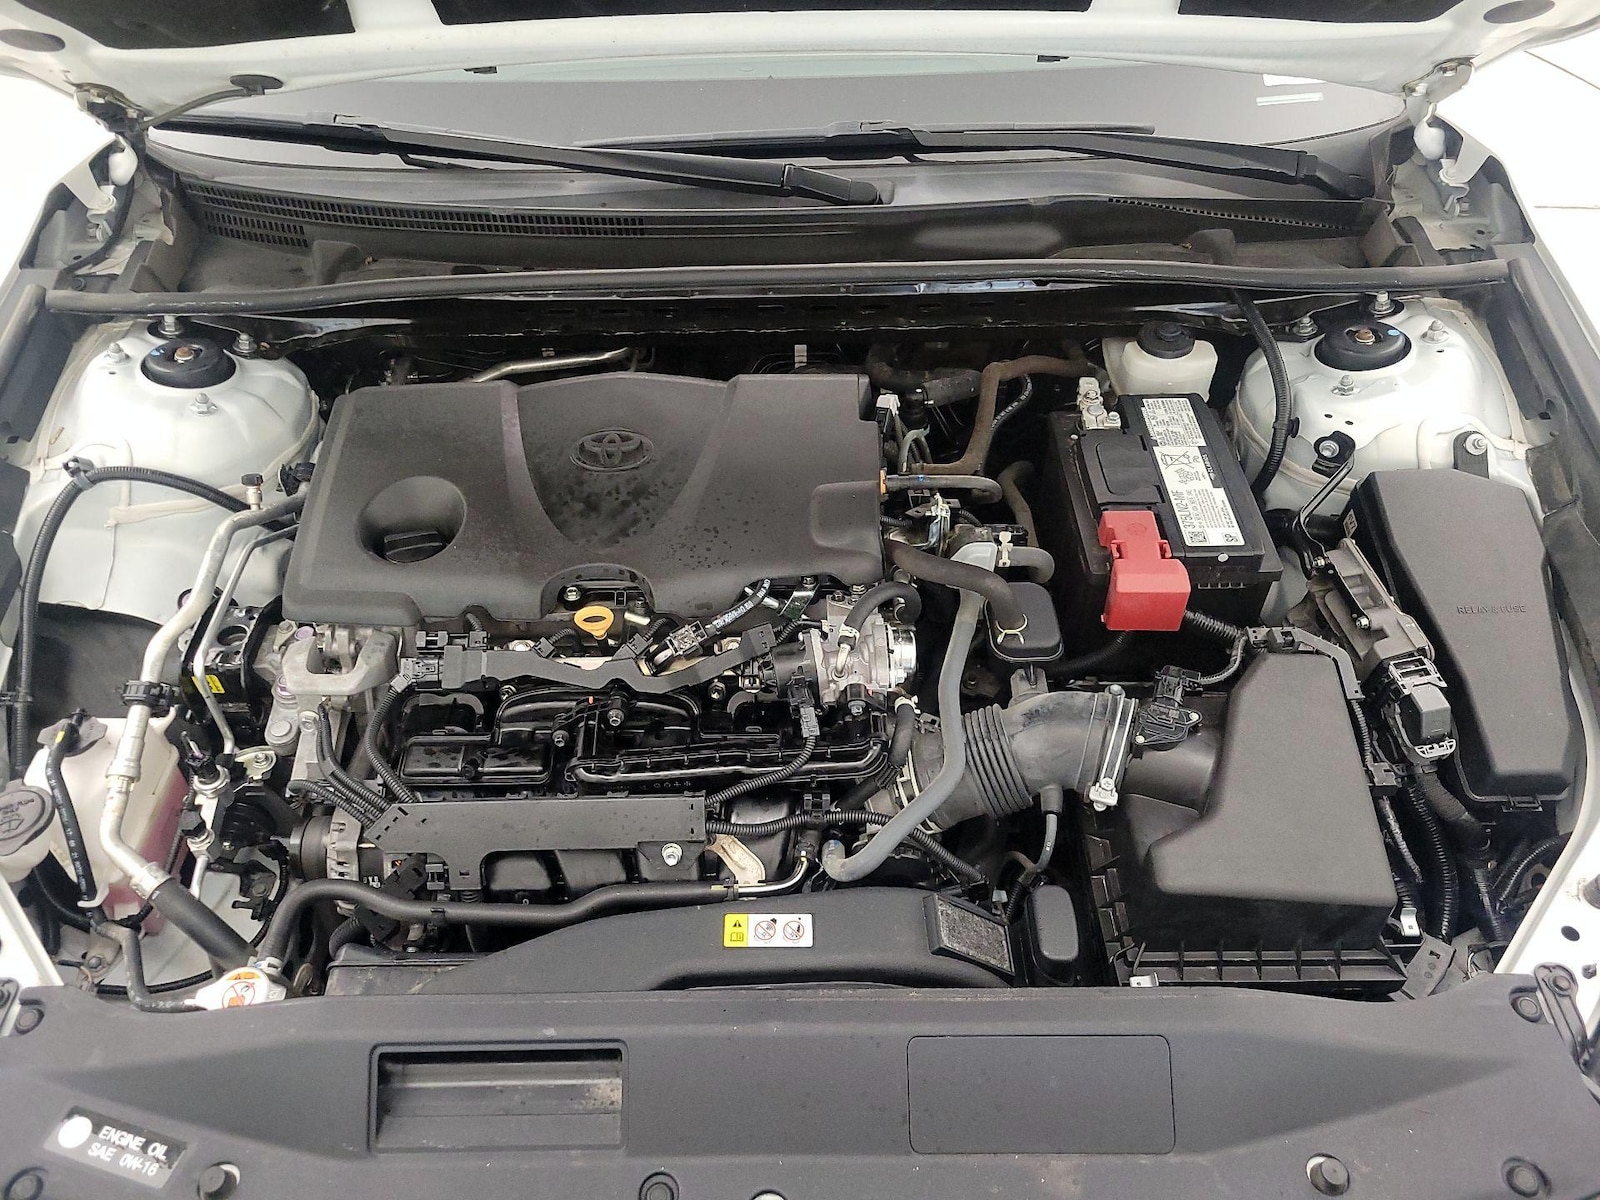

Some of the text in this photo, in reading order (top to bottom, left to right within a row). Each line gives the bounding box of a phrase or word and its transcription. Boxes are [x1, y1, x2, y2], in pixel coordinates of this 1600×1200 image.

[1224, 533, 1239, 543] SP
[1457, 605, 1488, 615] RELAY
[1500, 604, 1527, 614] FUSE
[98, 1125, 168, 1161] ENGINE OIL
[87, 1142, 117, 1162] SAE
